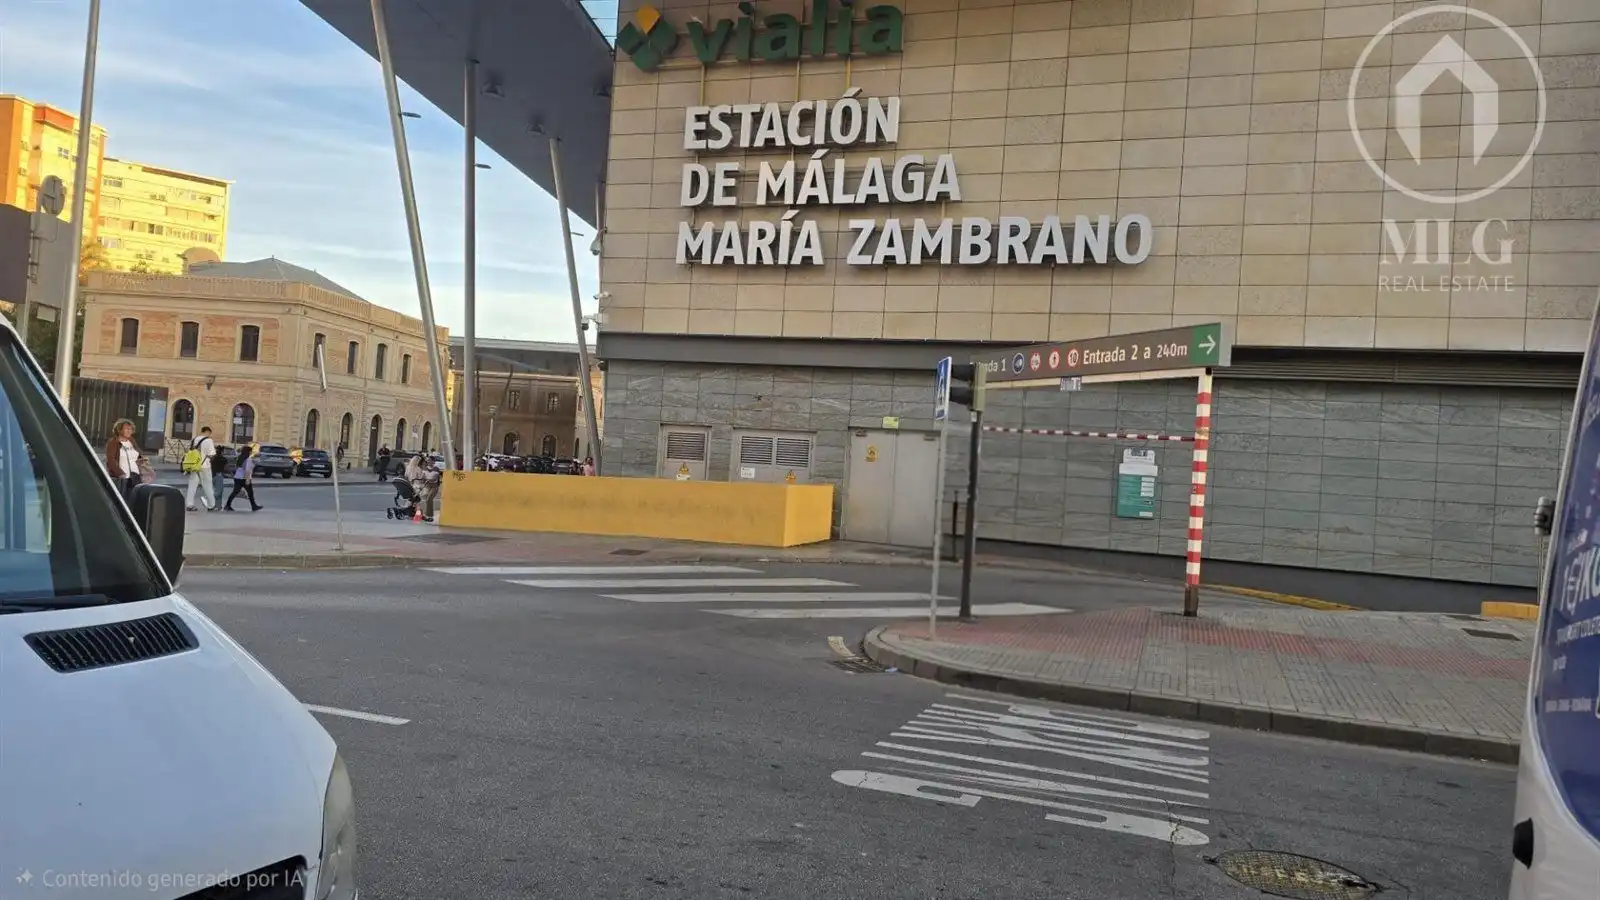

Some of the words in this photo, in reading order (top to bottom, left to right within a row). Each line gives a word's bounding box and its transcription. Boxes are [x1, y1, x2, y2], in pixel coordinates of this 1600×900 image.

[686, 0, 904, 63] vialia
[683, 87, 900, 150] ESTACIÓN
[680, 161, 739, 206] DE
[756, 149, 962, 205] MÁLAGA
[676, 210, 824, 265] MARÍA
[847, 213, 1153, 266] ZAMBRANO
[1001, 358, 1007, 372] 1
[1083, 346, 1126, 364] Entrada
[1131, 344, 1139, 360] 2
[1144, 346, 1151, 359] a
[1157, 343, 1188, 358] 240m
[830, 692, 1211, 846] PARKING
